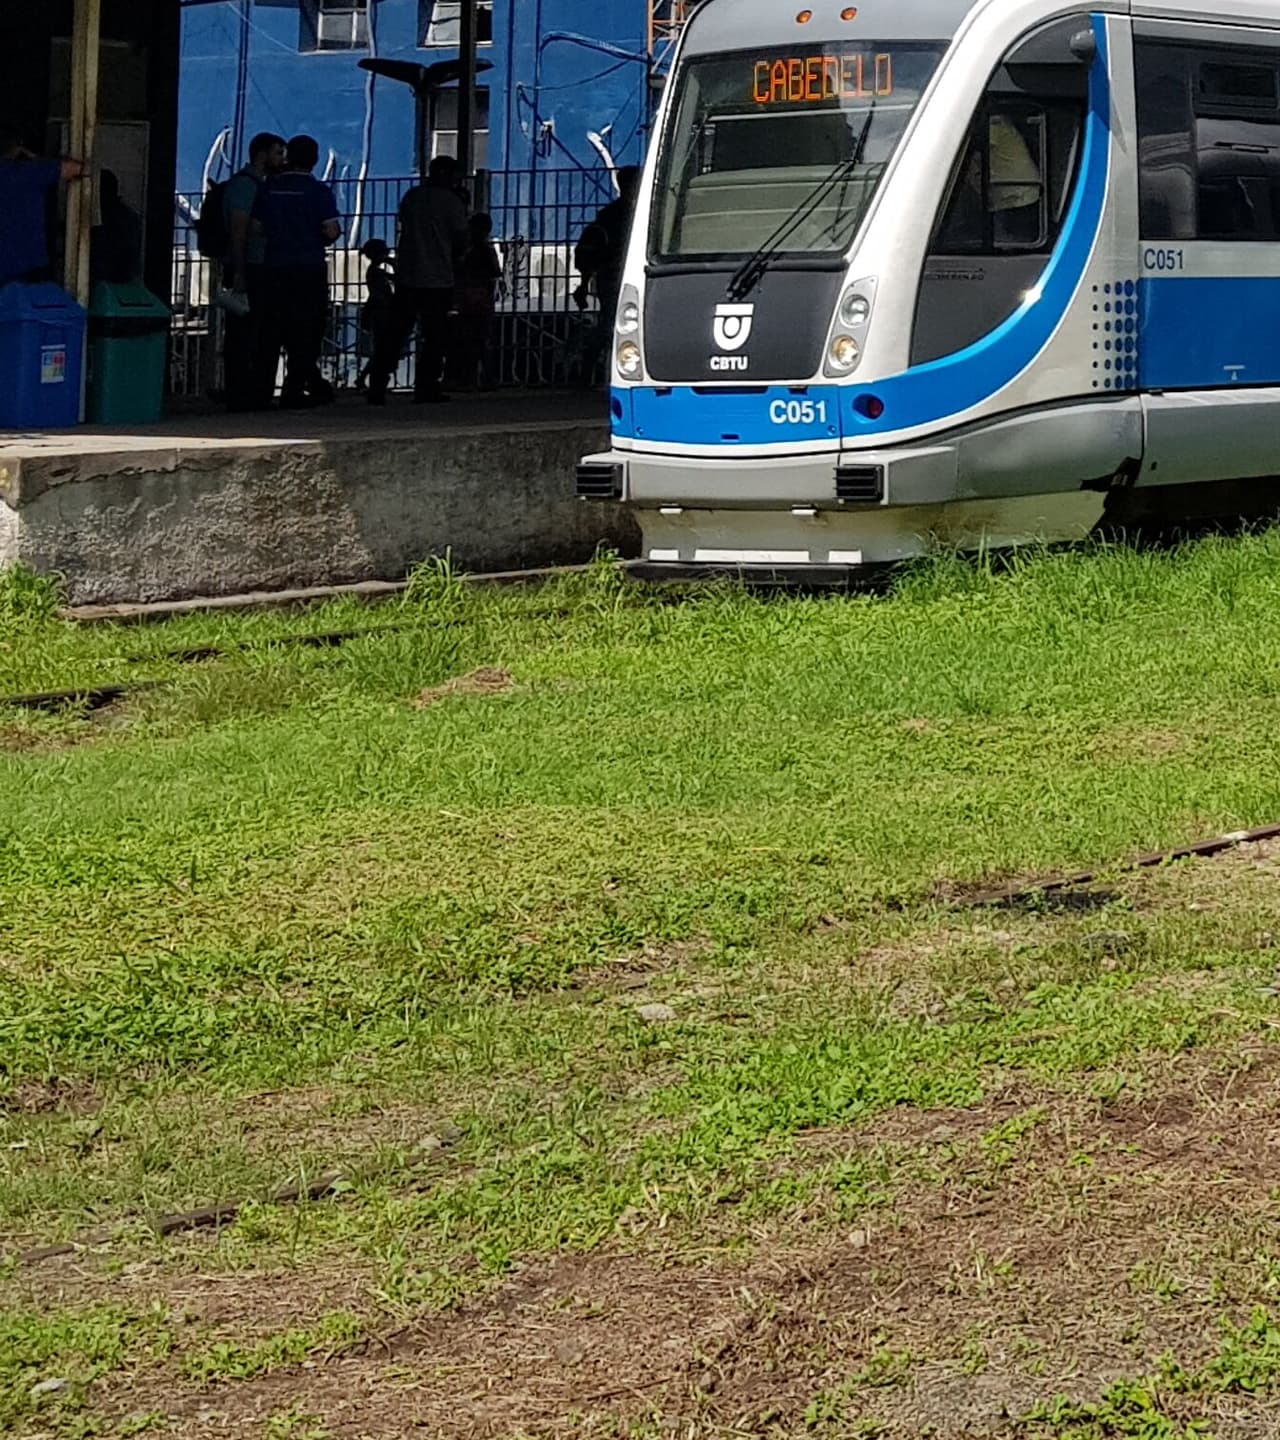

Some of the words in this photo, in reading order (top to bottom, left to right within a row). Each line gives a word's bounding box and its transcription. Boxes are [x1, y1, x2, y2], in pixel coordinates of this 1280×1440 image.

[753, 52, 892, 102] CABEDELO
[1143, 247, 1184, 270] C051
[709, 355, 749, 371] CBTU
[768, 399, 827, 424] C051
